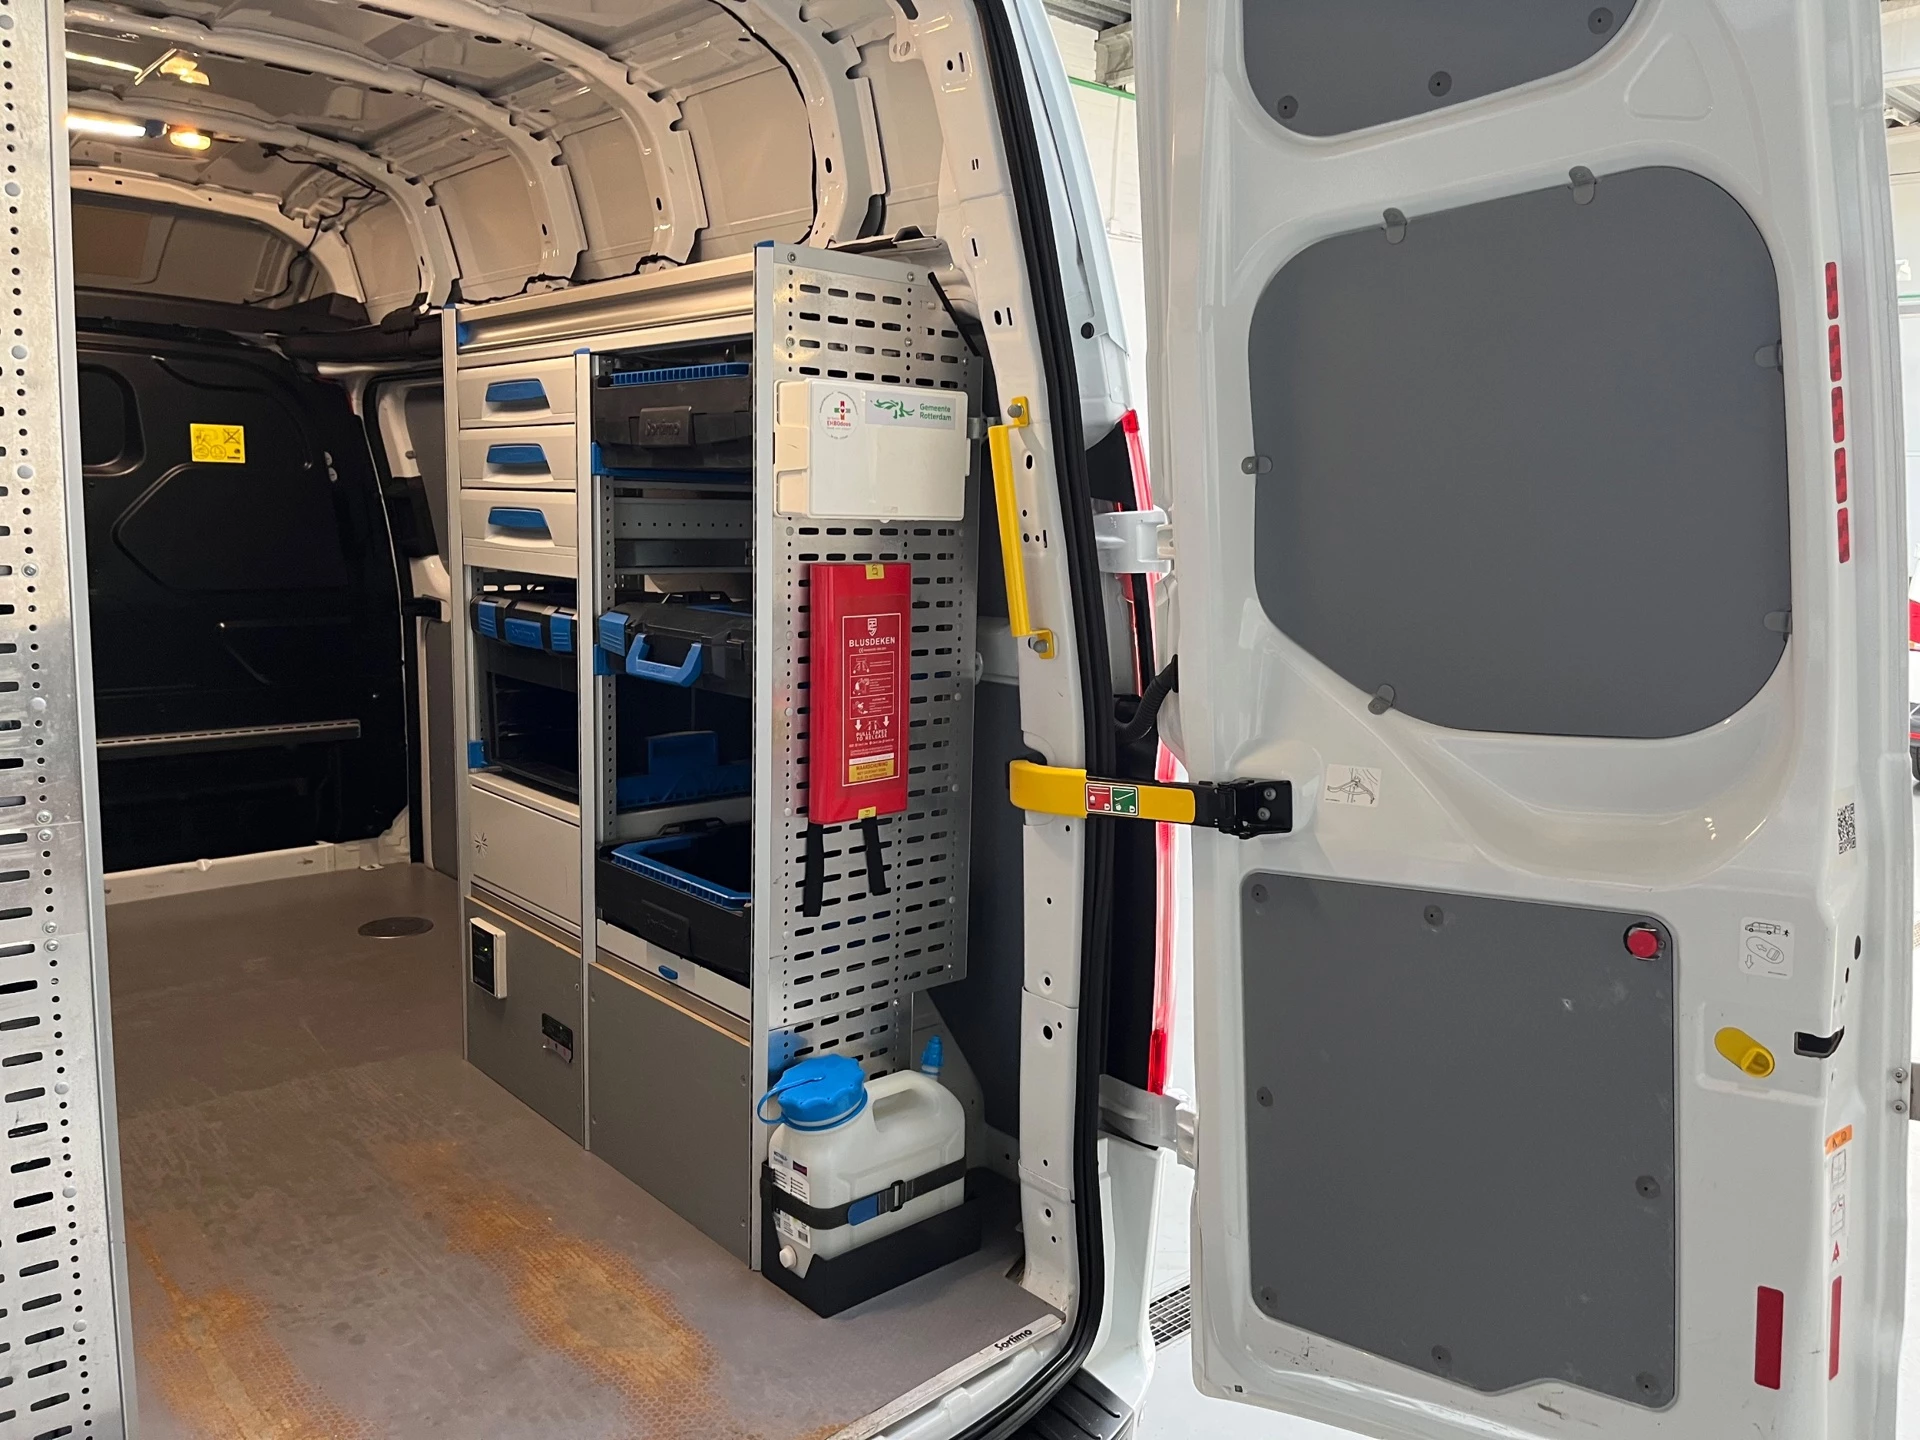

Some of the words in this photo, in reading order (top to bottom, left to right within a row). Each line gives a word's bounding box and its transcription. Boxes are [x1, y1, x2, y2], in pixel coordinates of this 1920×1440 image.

[919, 403, 951, 413] Gemeente
[919, 411, 952, 421] Rotterdam
[849, 636, 896, 647] BLUSDEKEN
[994, 1329, 1033, 1351] Sortimo
